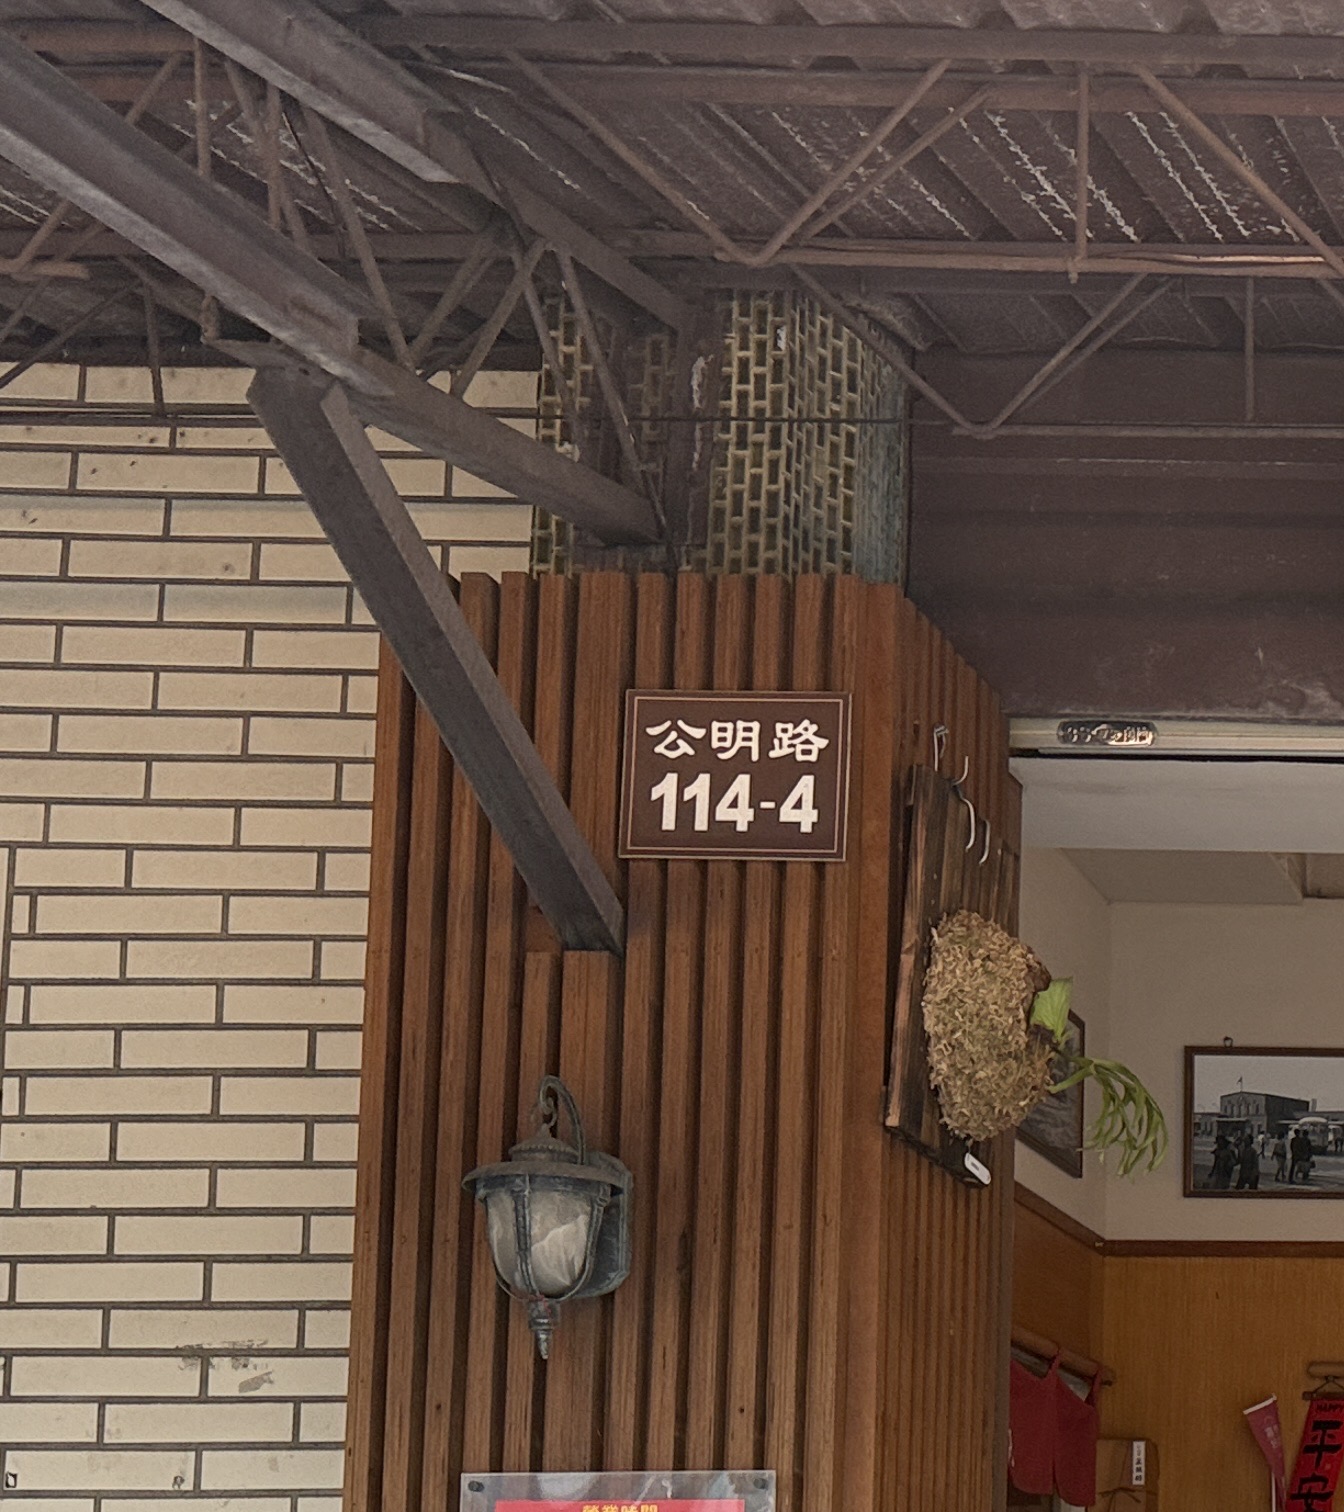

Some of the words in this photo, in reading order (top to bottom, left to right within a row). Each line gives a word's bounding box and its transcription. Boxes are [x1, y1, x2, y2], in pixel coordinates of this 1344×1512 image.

[646, 719, 829, 762] 公明路
[650, 773, 818, 833] 114-4
